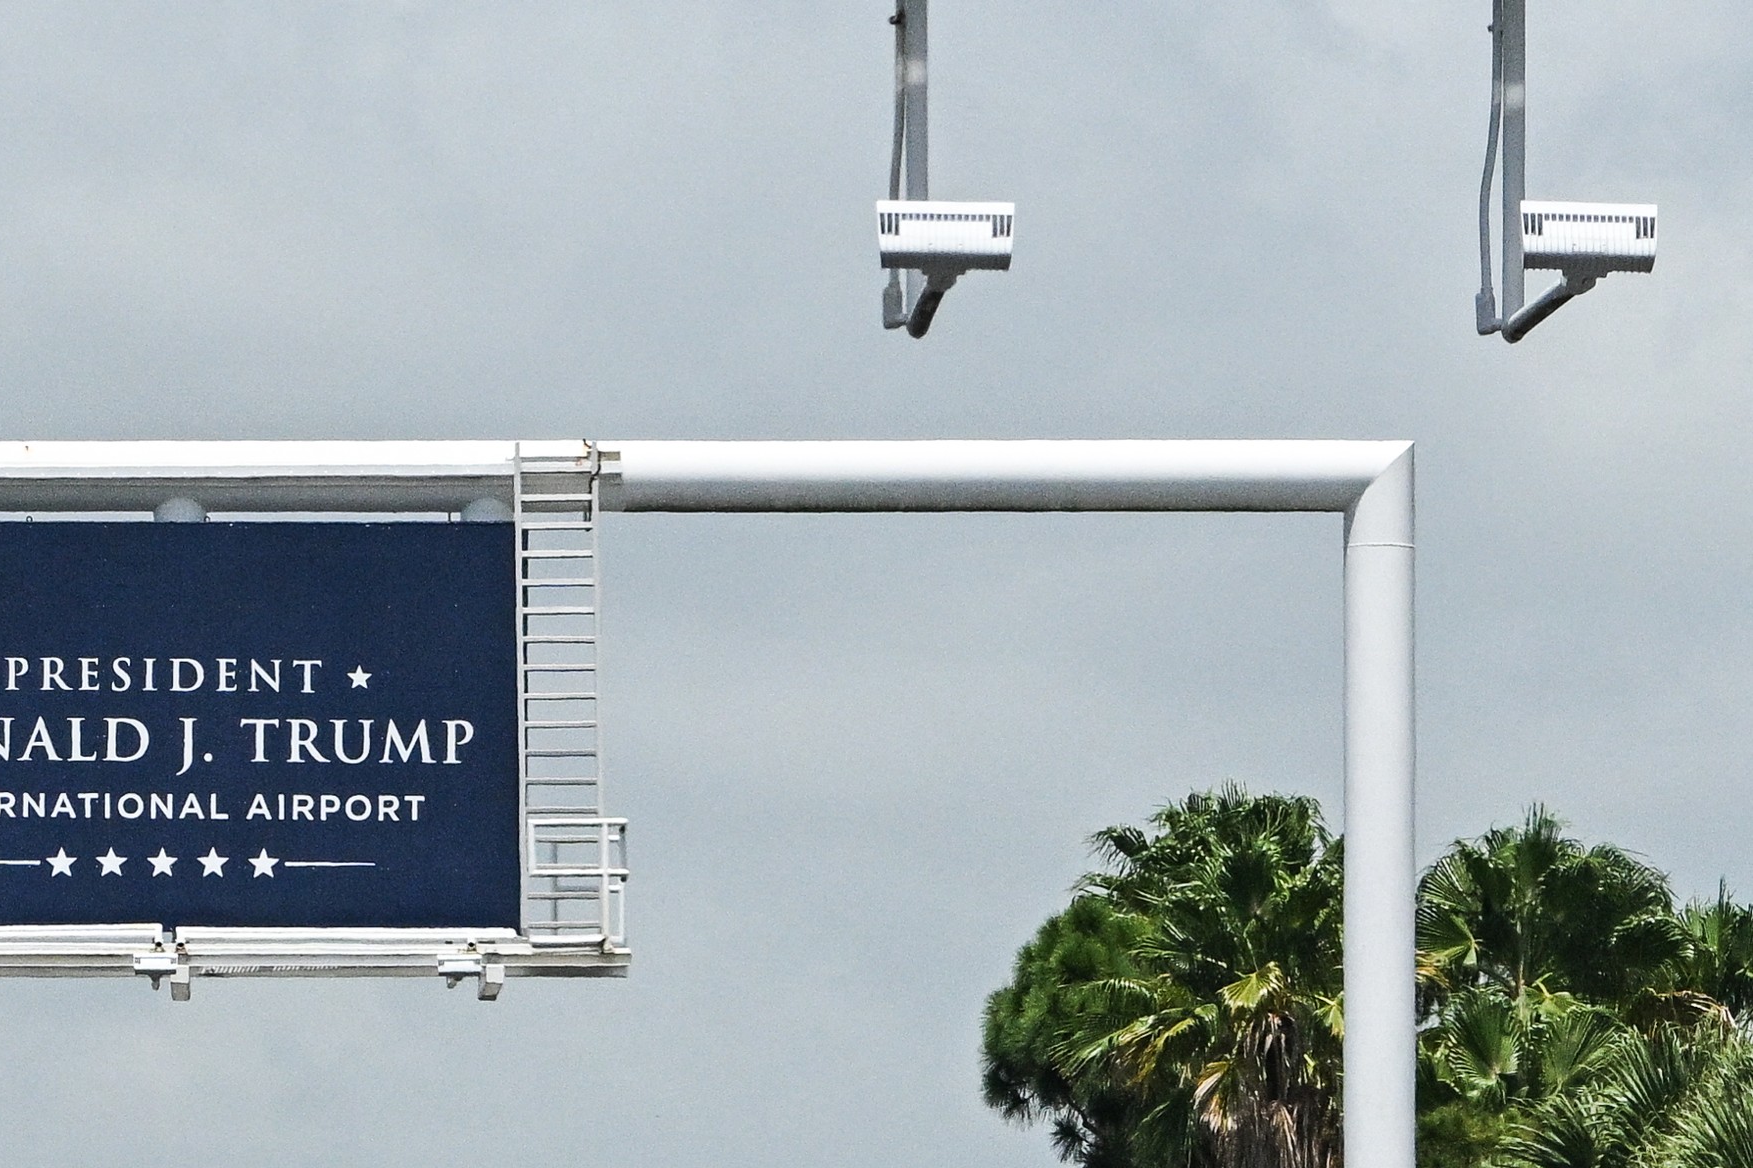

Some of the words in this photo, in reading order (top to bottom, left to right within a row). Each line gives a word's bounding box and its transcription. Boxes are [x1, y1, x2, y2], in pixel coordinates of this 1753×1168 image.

[4, 656, 323, 694] PRESIDENT
[175, 717, 213, 776] J.
[239, 718, 474, 765] TRUMP
[245, 793, 426, 822] AIRPORT
